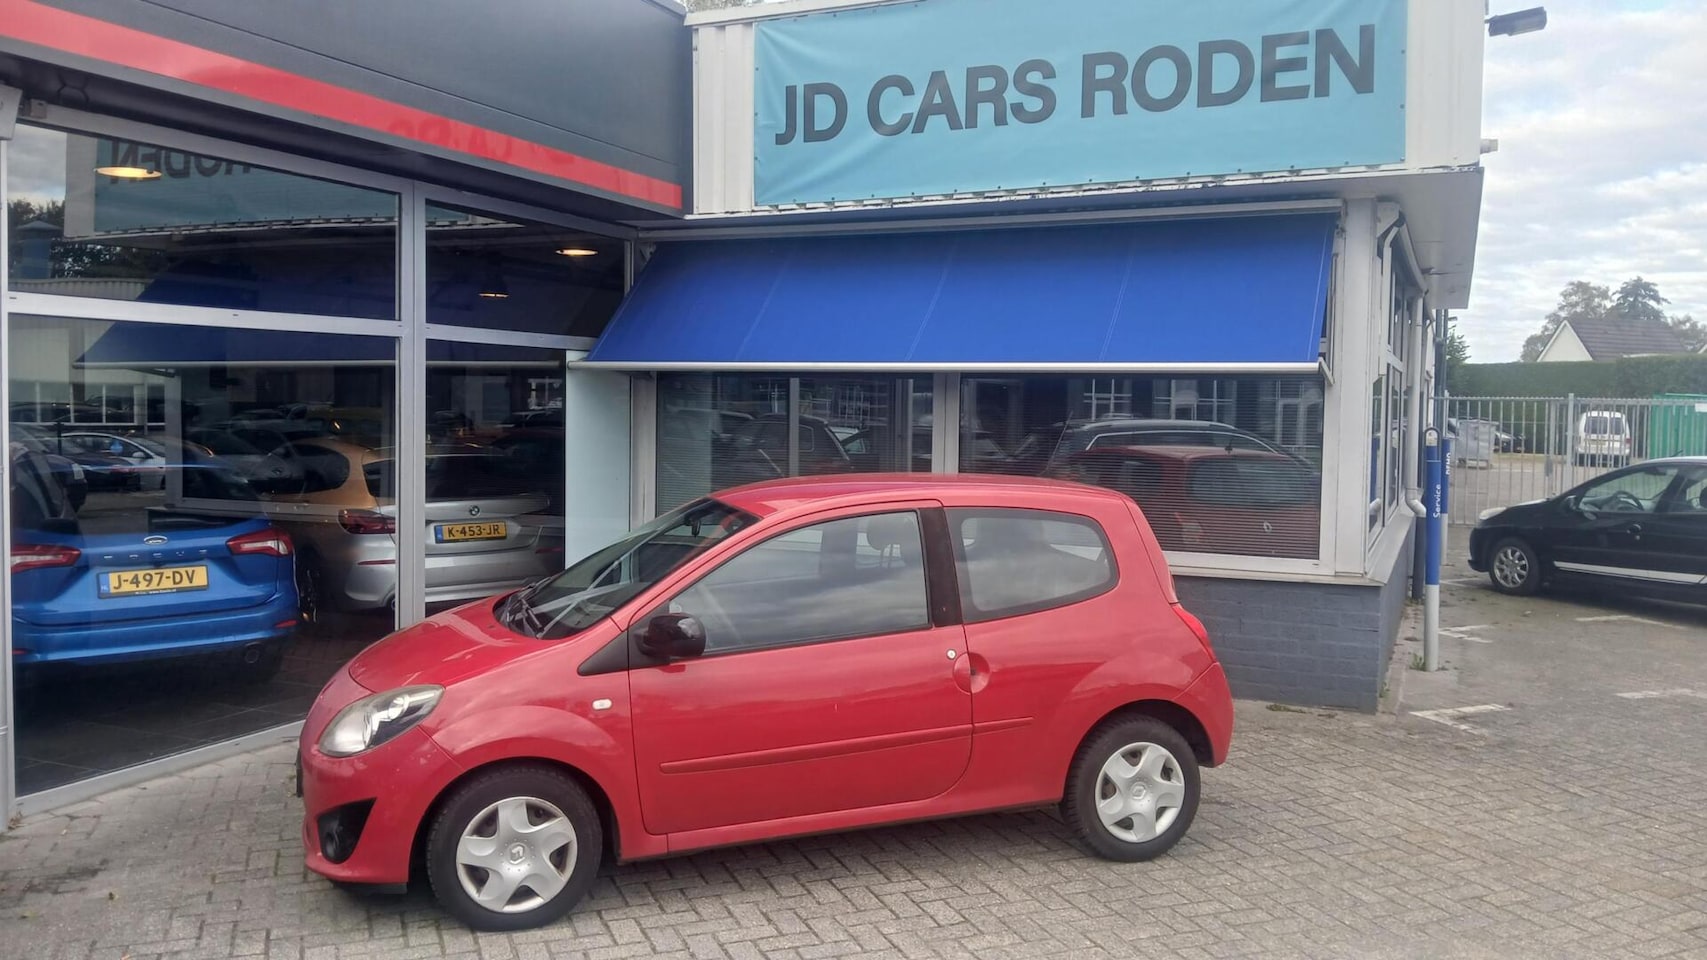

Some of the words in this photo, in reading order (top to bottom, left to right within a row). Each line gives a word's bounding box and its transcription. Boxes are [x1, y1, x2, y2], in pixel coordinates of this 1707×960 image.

[775, 82, 848, 146] JD
[866, 58, 1057, 137] CARS
[1080, 24, 1376, 119] RODEN
[1433, 484, 1441, 518] Service
[447, 524, 501, 538] K-453-JR
[112, 569, 196, 590] J-497-DV
